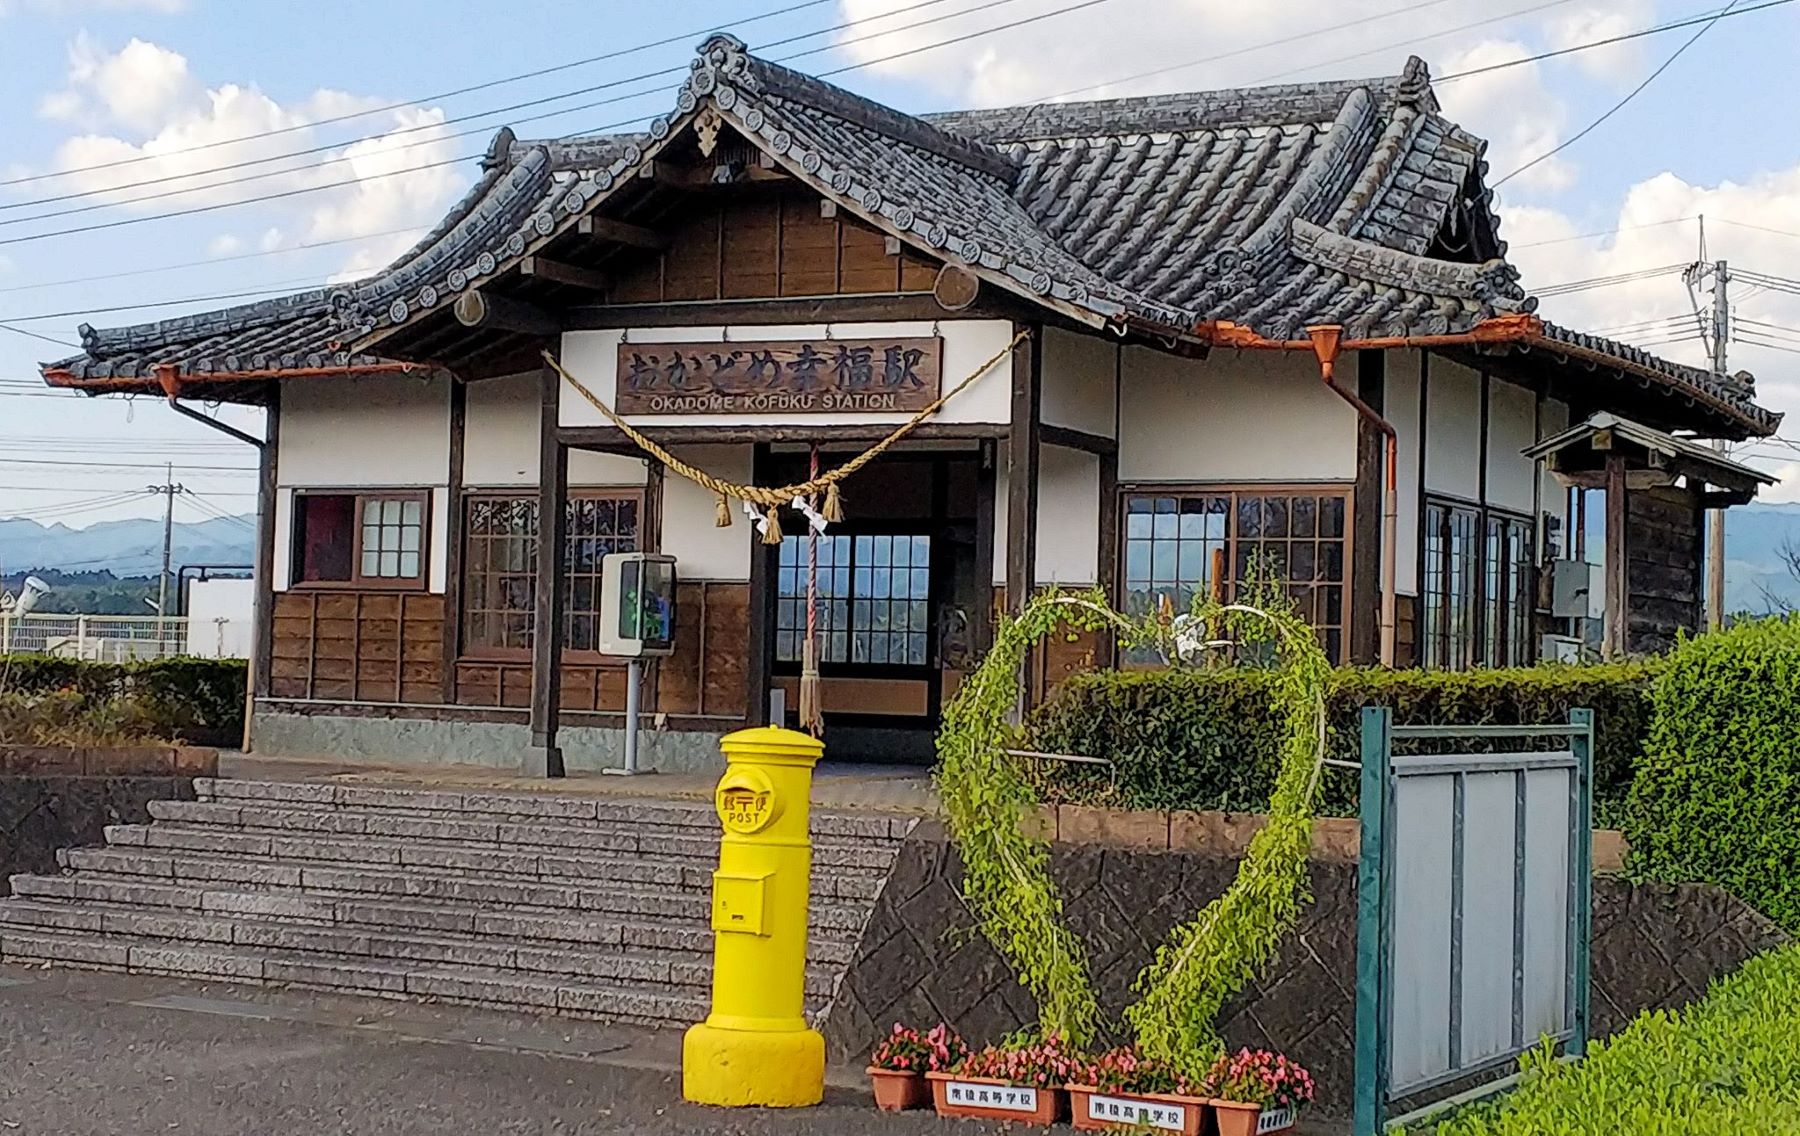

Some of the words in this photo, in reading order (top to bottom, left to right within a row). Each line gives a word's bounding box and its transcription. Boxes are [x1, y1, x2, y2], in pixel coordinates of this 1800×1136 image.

[650, 396, 734, 411] OKADOME
[744, 394, 814, 410] KOFUKU
[822, 393, 895, 409] STATION
[728, 812, 760, 824] POST
